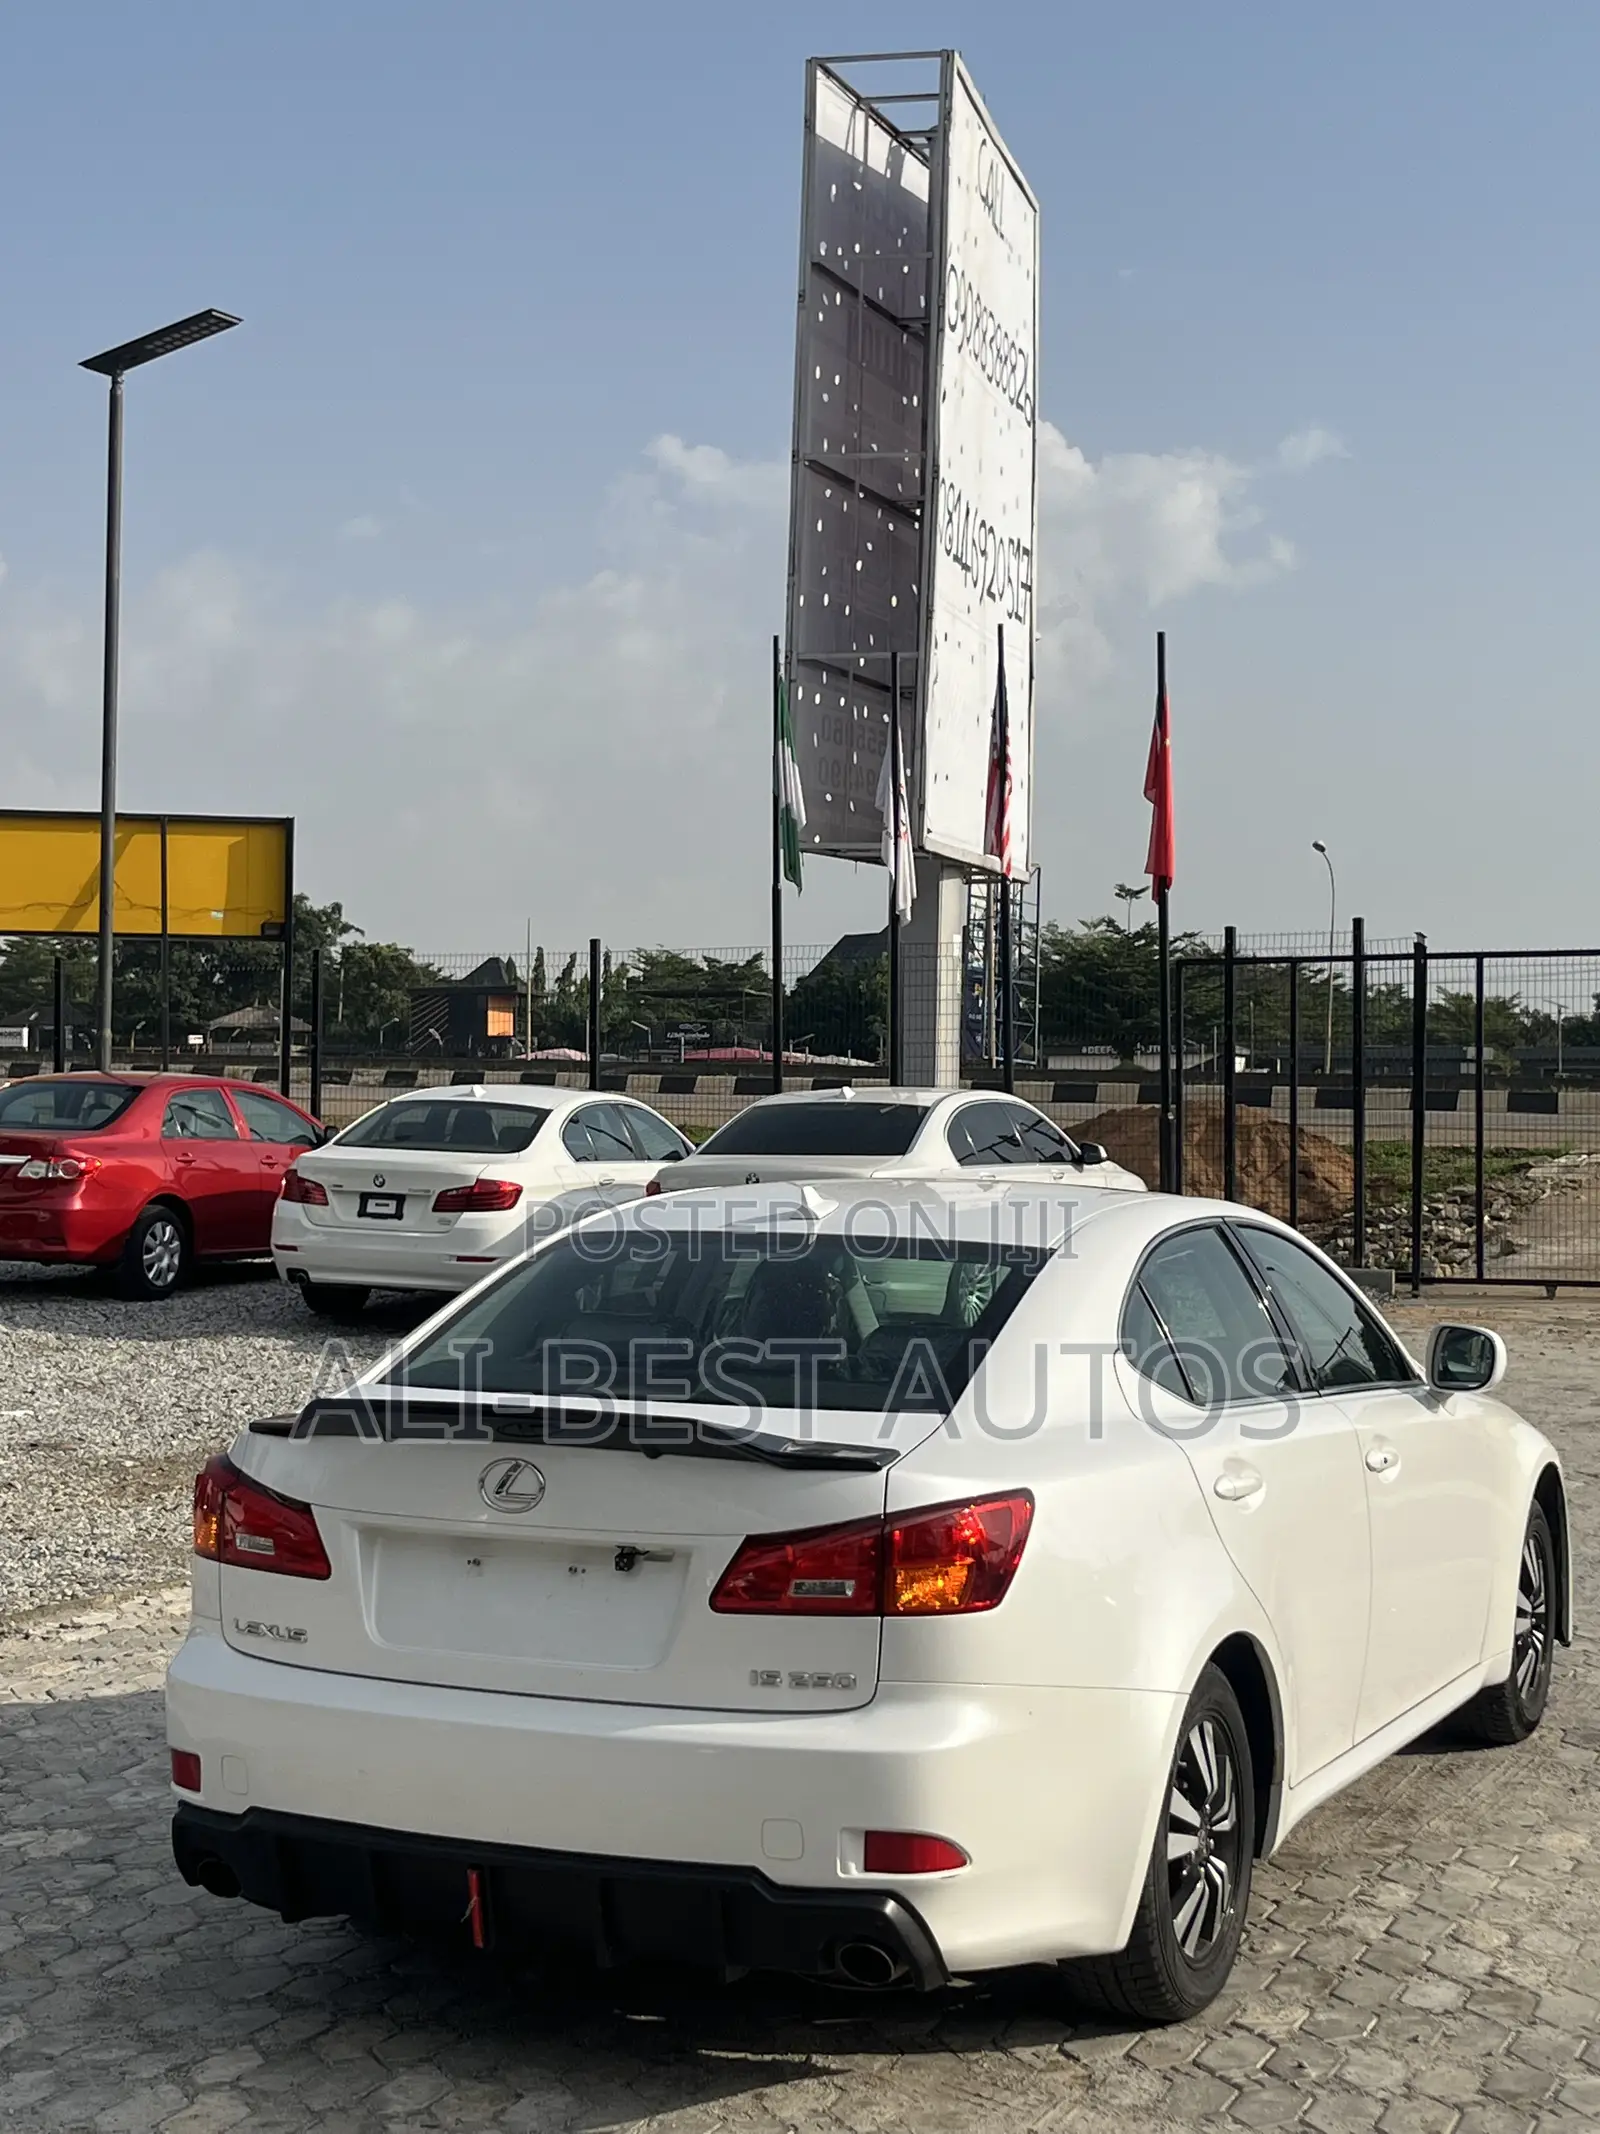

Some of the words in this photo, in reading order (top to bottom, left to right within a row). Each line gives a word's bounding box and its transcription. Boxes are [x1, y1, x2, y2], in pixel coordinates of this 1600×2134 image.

[977, 138, 1005, 241] CALL
[233, 1617, 308, 1643] LEXUS
[749, 1670, 782, 1688] IS
[788, 1671, 857, 1690] 250
